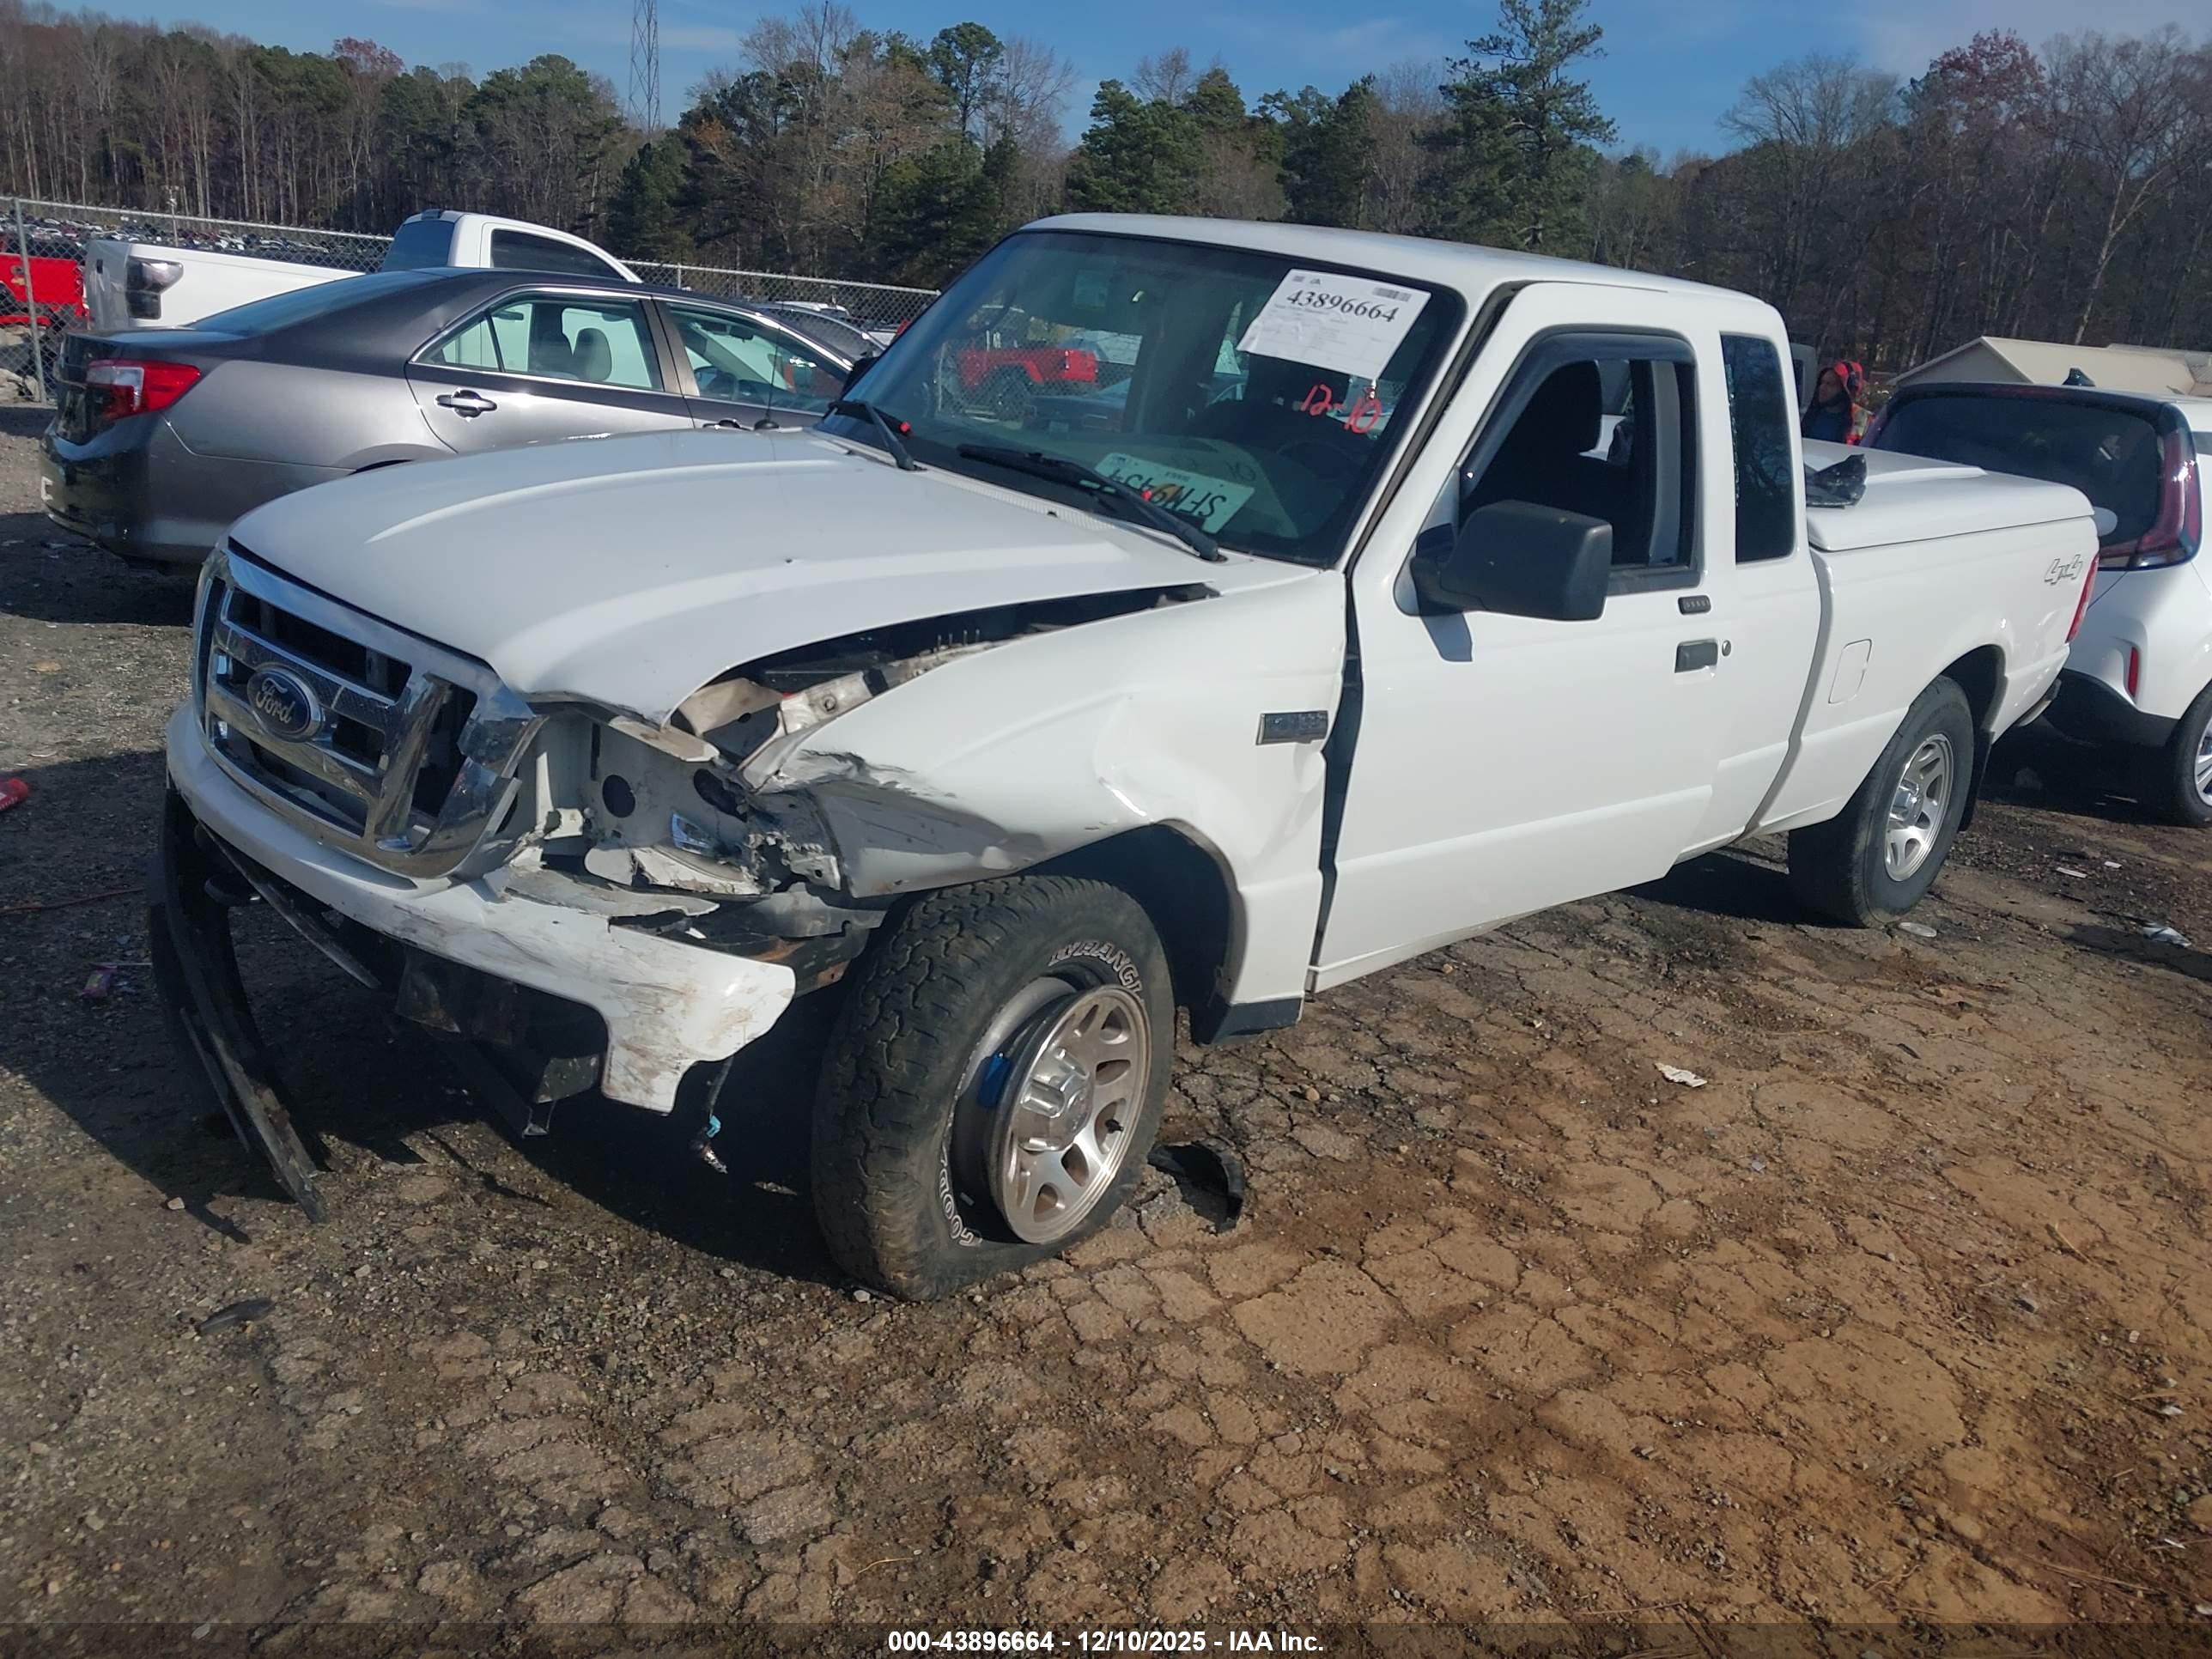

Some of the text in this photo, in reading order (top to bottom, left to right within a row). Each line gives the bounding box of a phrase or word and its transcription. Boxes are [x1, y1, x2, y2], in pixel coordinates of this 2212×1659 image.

[1286, 289, 1400, 323] 43896664
[2044, 554, 2083, 586] 4x4
[256, 678, 296, 725] Ford
